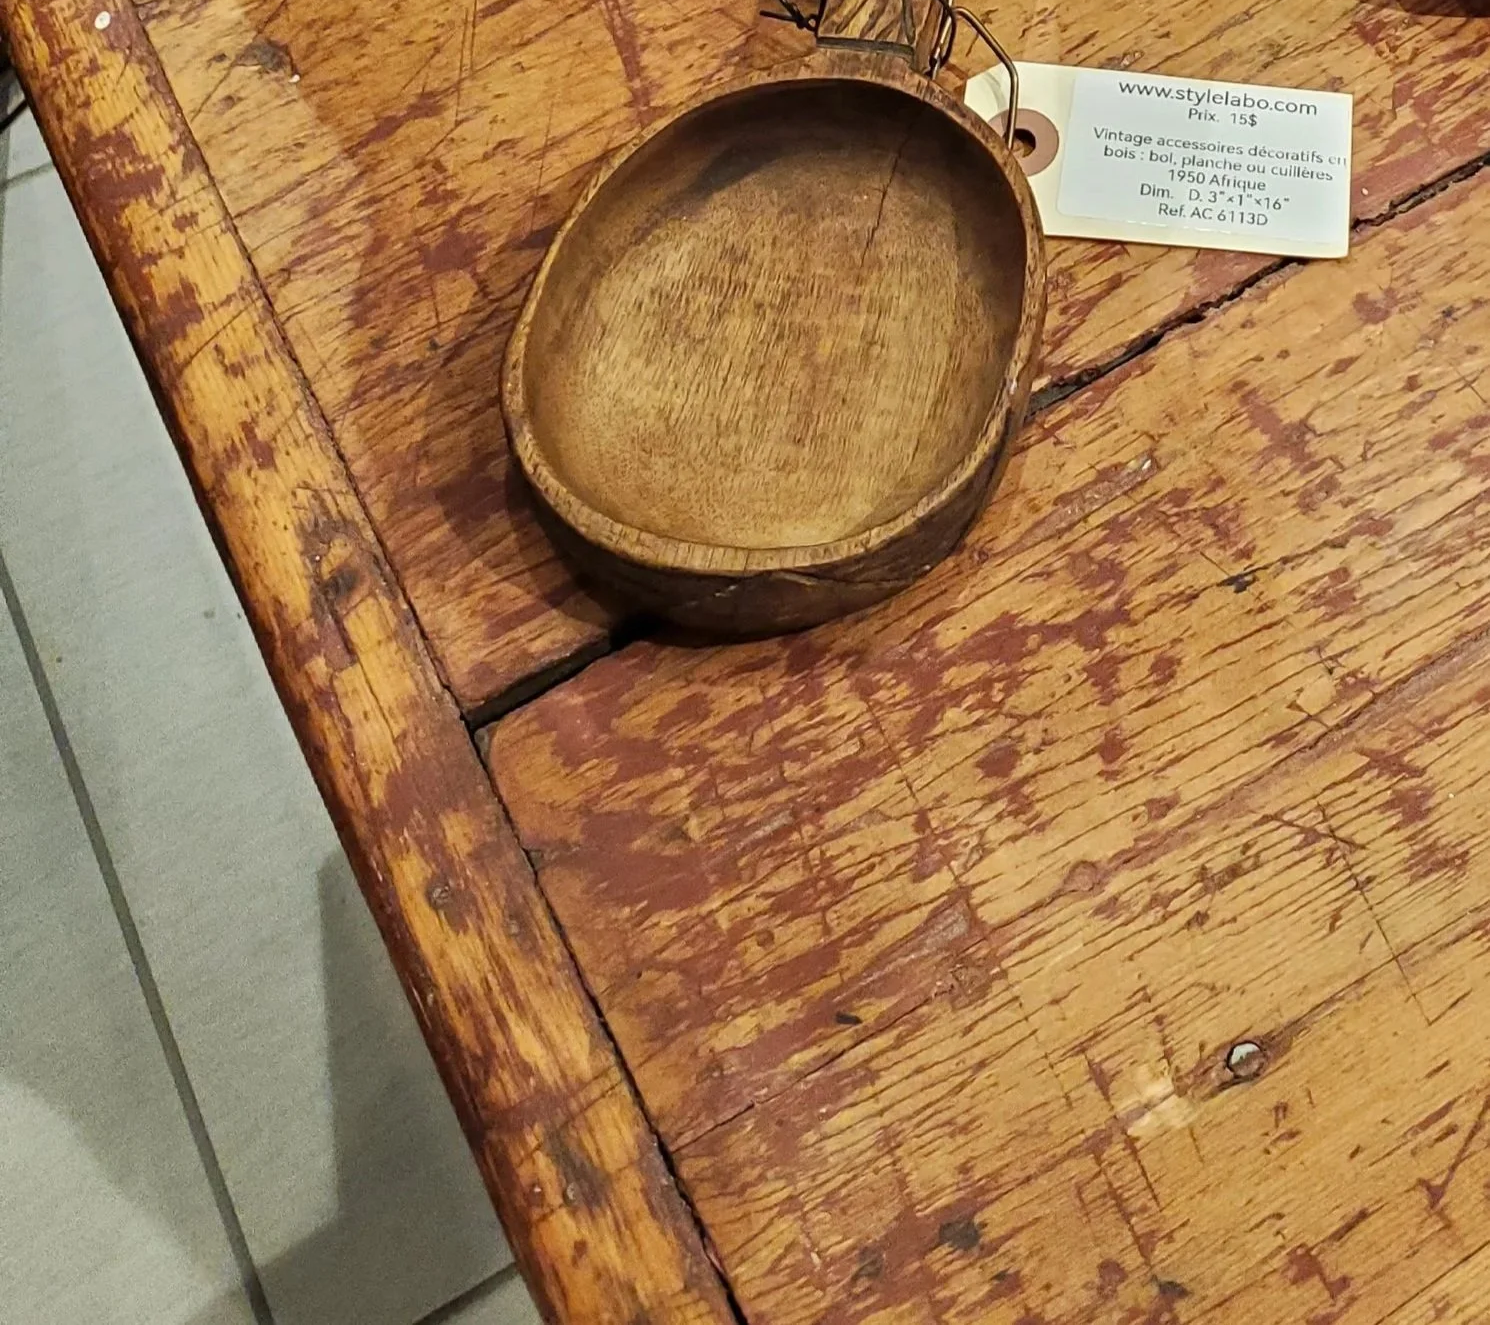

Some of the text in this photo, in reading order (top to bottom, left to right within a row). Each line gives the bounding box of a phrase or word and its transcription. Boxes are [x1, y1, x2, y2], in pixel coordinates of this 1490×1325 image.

[1118, 81, 1318, 116] www.stylelabo.com
[1188, 107, 1258, 128] Prix. 15$
[1093, 126, 1153, 147] Vintage
[1156, 135, 1244, 156] accessoires
[1248, 145, 1324, 164] décoratifs
[1103, 145, 1136, 160] bois
[1149, 150, 1177, 166] bol,
[1181, 153, 1242, 171] planche
[1246, 163, 1266, 174] ou
[1271, 164, 1333, 181] cuillères
[1140, 183, 1174, 199] Dim.
[1188, 189, 1203, 202] D.
[1168, 169, 1266, 193] 1950 Afrique
[1158, 203, 1269, 226] Ref. AC 6113D
